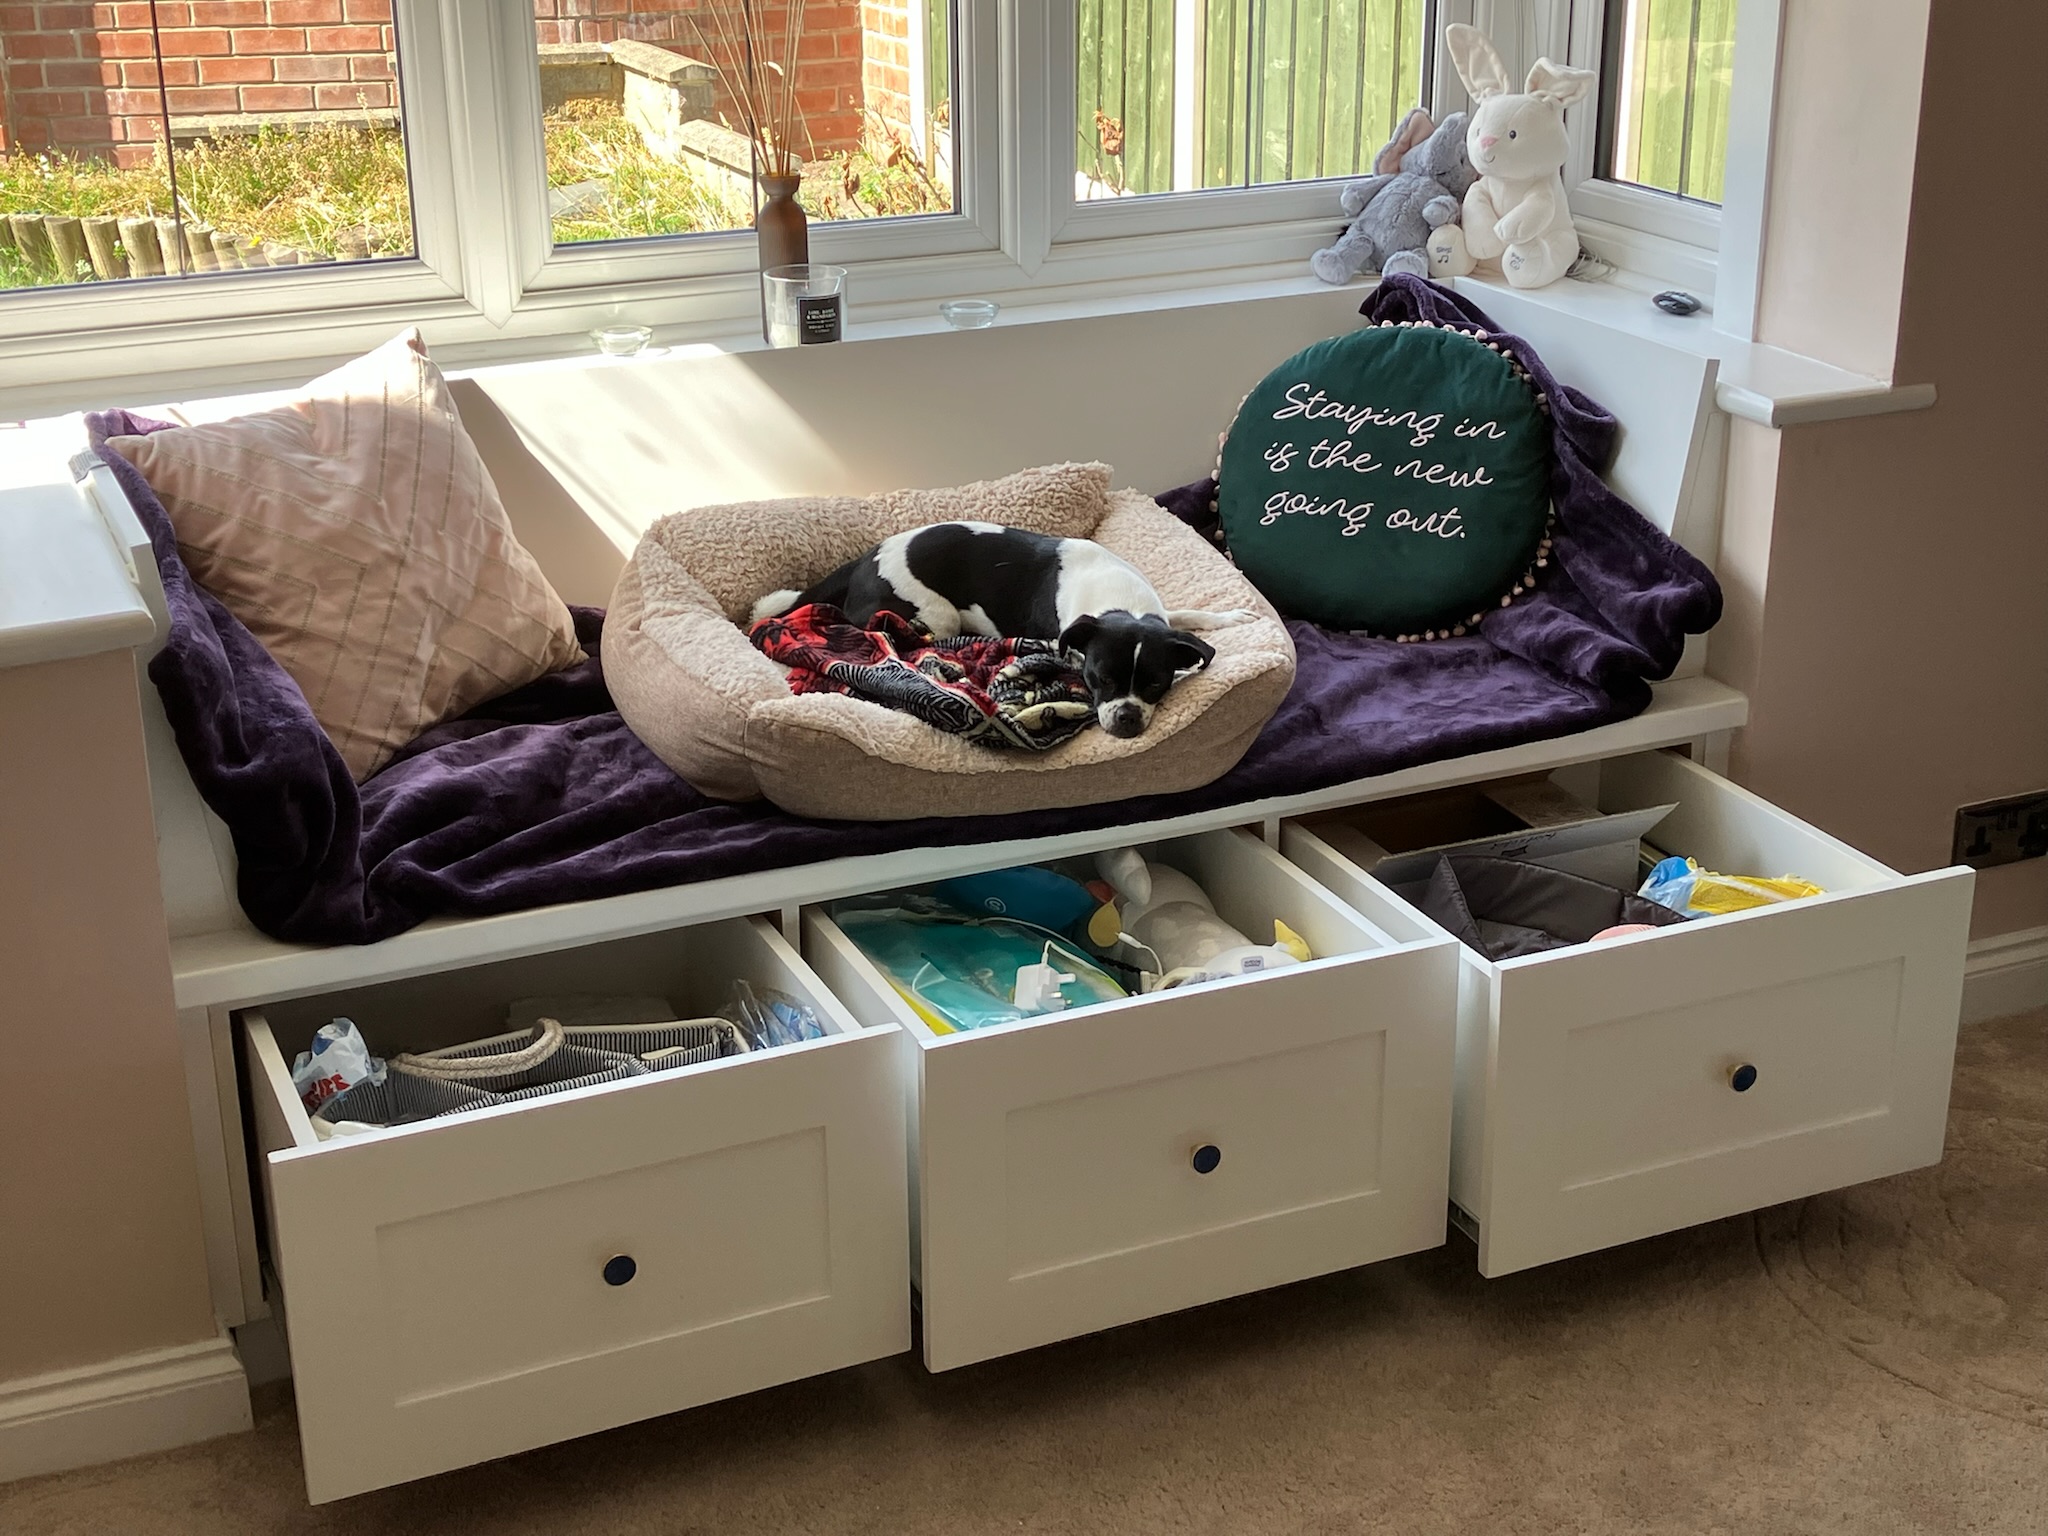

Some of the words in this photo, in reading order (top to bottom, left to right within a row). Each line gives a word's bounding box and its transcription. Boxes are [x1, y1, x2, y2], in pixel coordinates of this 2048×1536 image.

[1272, 382, 1445, 447] Staying
[1453, 417, 1507, 439] in
[1263, 440, 1300, 473] is
[1307, 438, 1383, 473] the
[1393, 459, 1494, 488] new
[1259, 491, 1375, 537] going
[1385, 507, 1466, 539] out.
